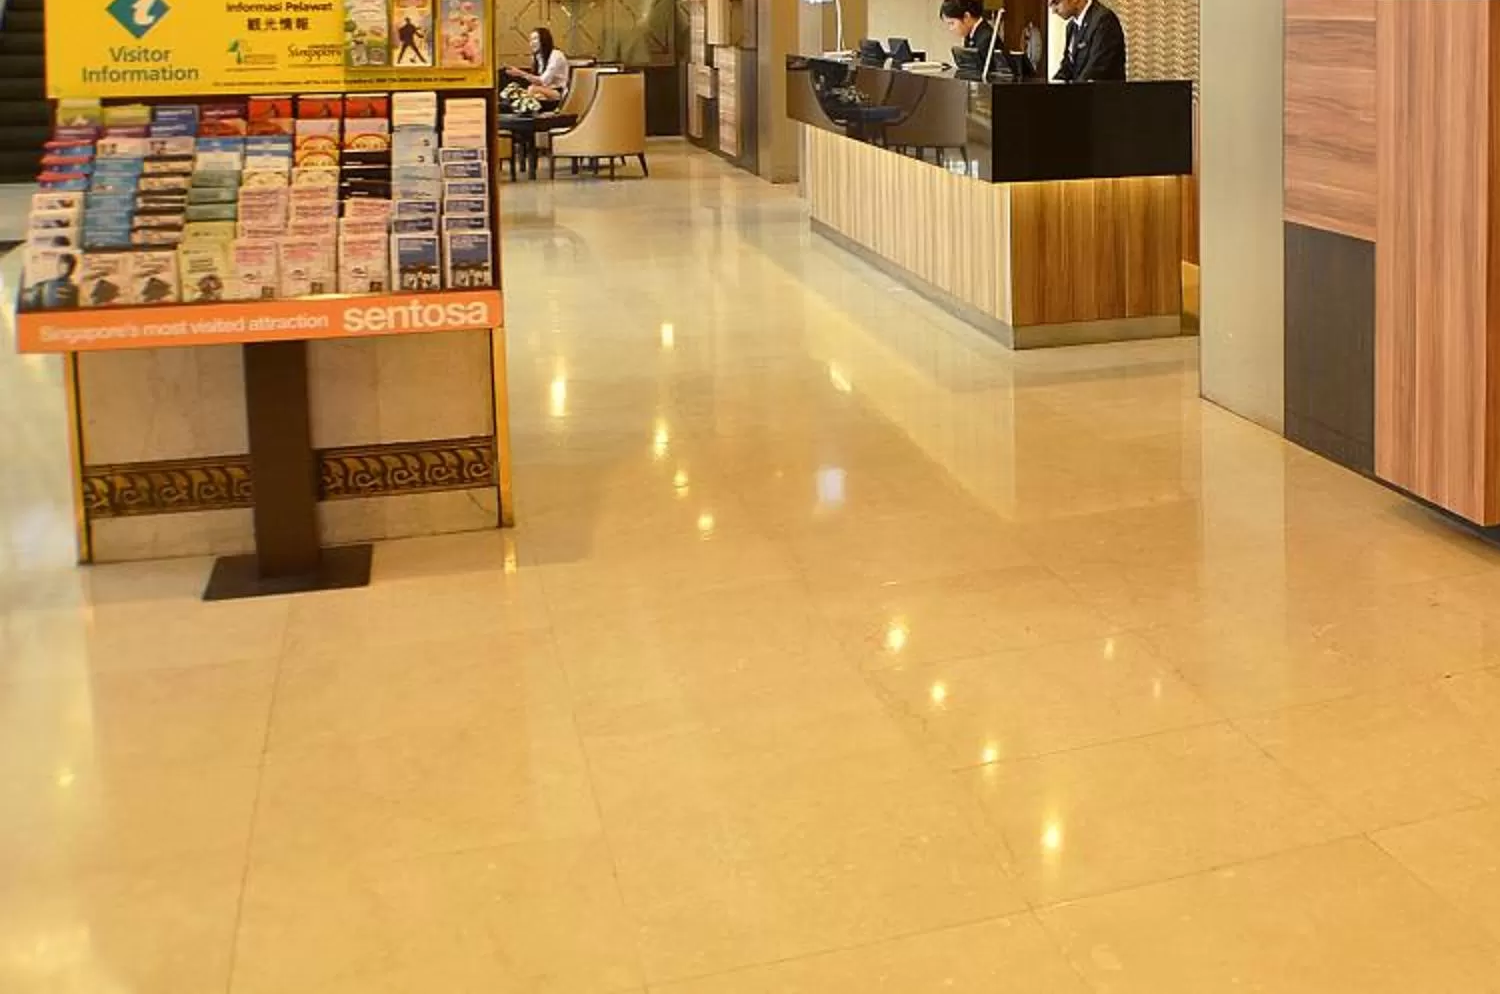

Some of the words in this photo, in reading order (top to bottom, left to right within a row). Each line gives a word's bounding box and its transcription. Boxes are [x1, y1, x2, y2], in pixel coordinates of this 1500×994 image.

[225, 2, 282, 13] Informasi
[285, 1, 333, 12] Pelawat
[109, 46, 171, 63] Visitor
[82, 65, 199, 83] Information
[343, 299, 488, 332] sentosa
[40, 324, 138, 344] Singapore's
[143, 321, 188, 336] most
[191, 317, 244, 334] visited
[249, 313, 329, 331] attraction
